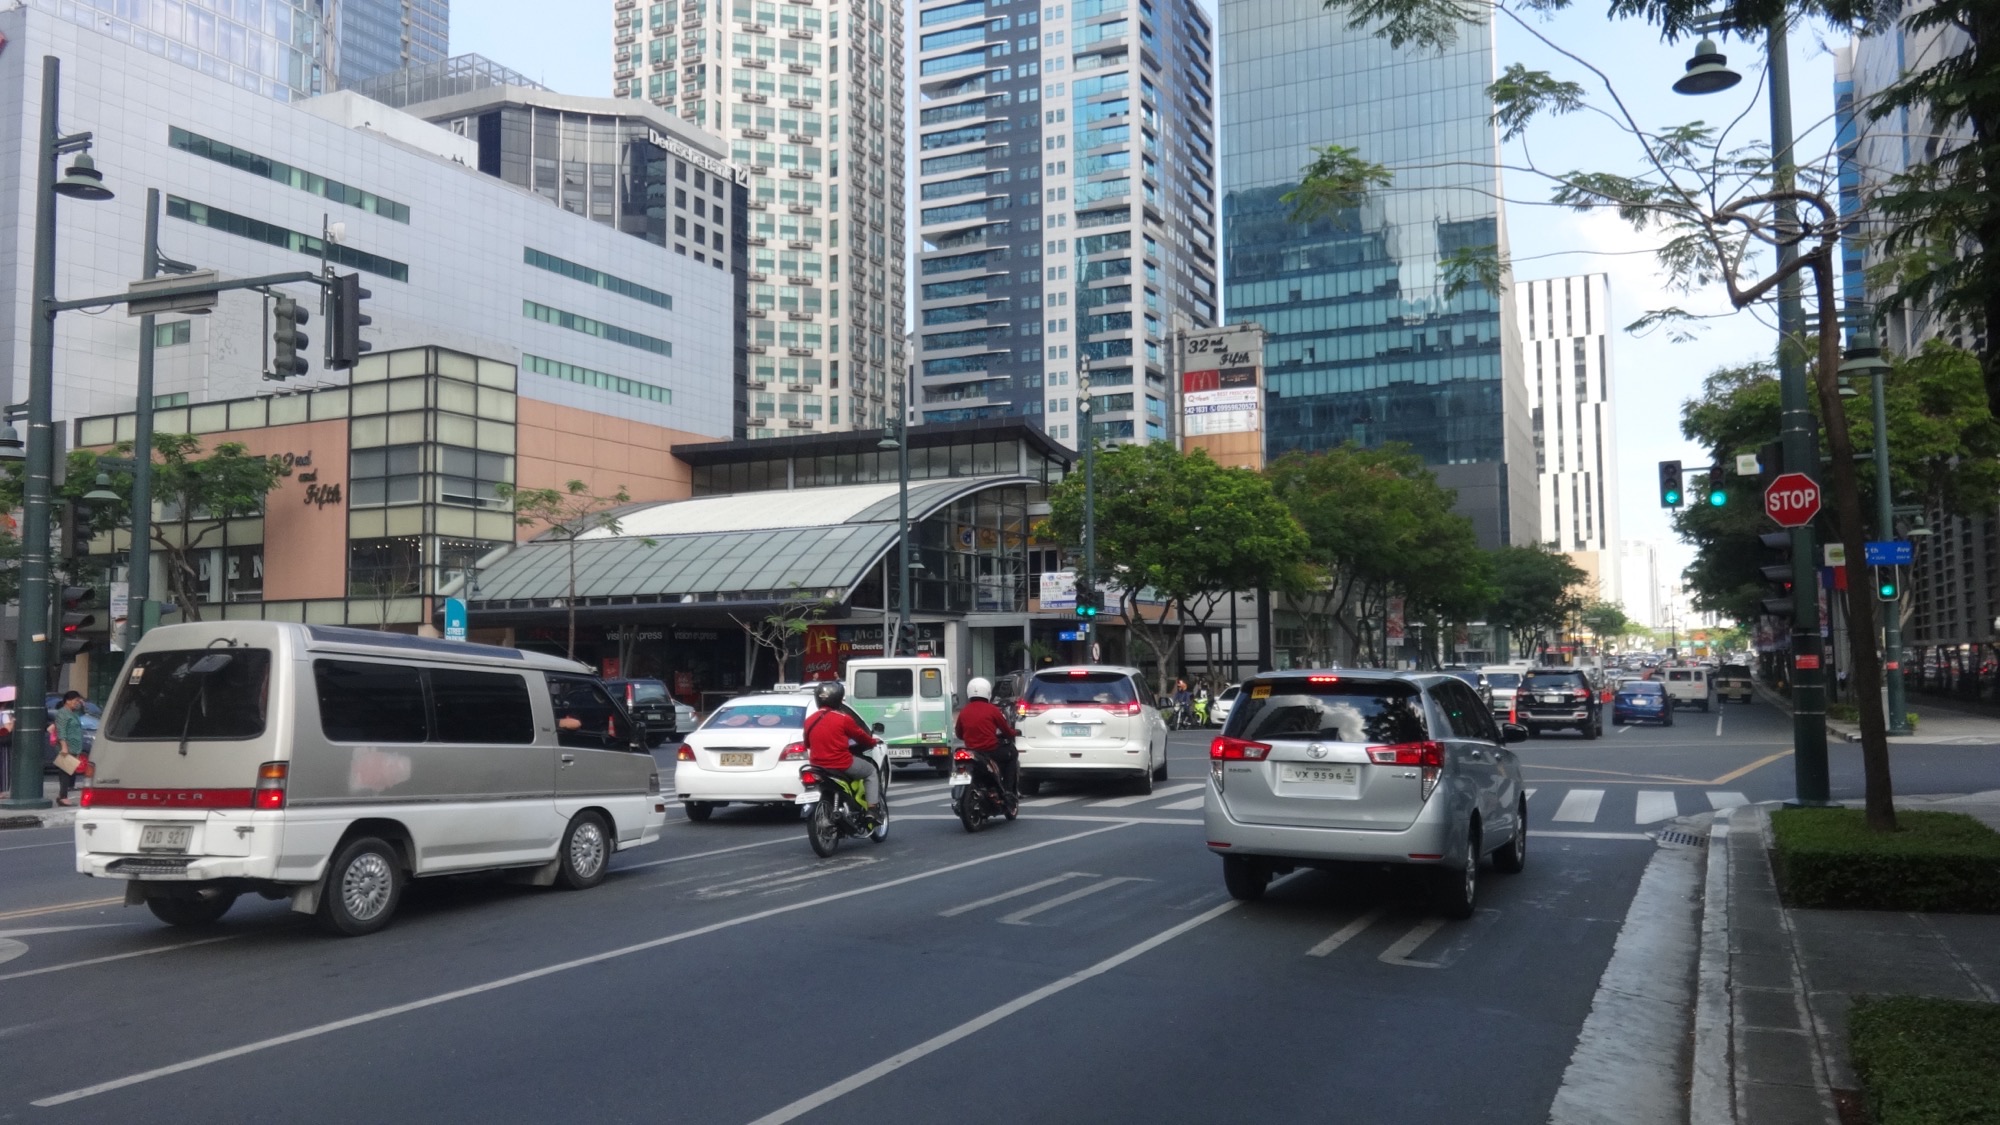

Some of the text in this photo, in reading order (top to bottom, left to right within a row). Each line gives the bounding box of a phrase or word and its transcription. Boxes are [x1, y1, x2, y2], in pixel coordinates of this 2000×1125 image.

[705, 157, 733, 182] Bank
[1213, 345, 1228, 353] and
[1219, 352, 1250, 367] Fifth
[298, 468, 318, 482] and
[304, 483, 342, 511] Fifth
[1769, 488, 1816, 511] STOP
[452, 619, 460, 627] NO
[446, 627, 465, 635] STREET
[851, 643, 883, 651] Desserts
[1295, 771, 1309, 779] VX
[1313, 771, 1342, 780] 9596
[145, 831, 185, 844] RAD 921
